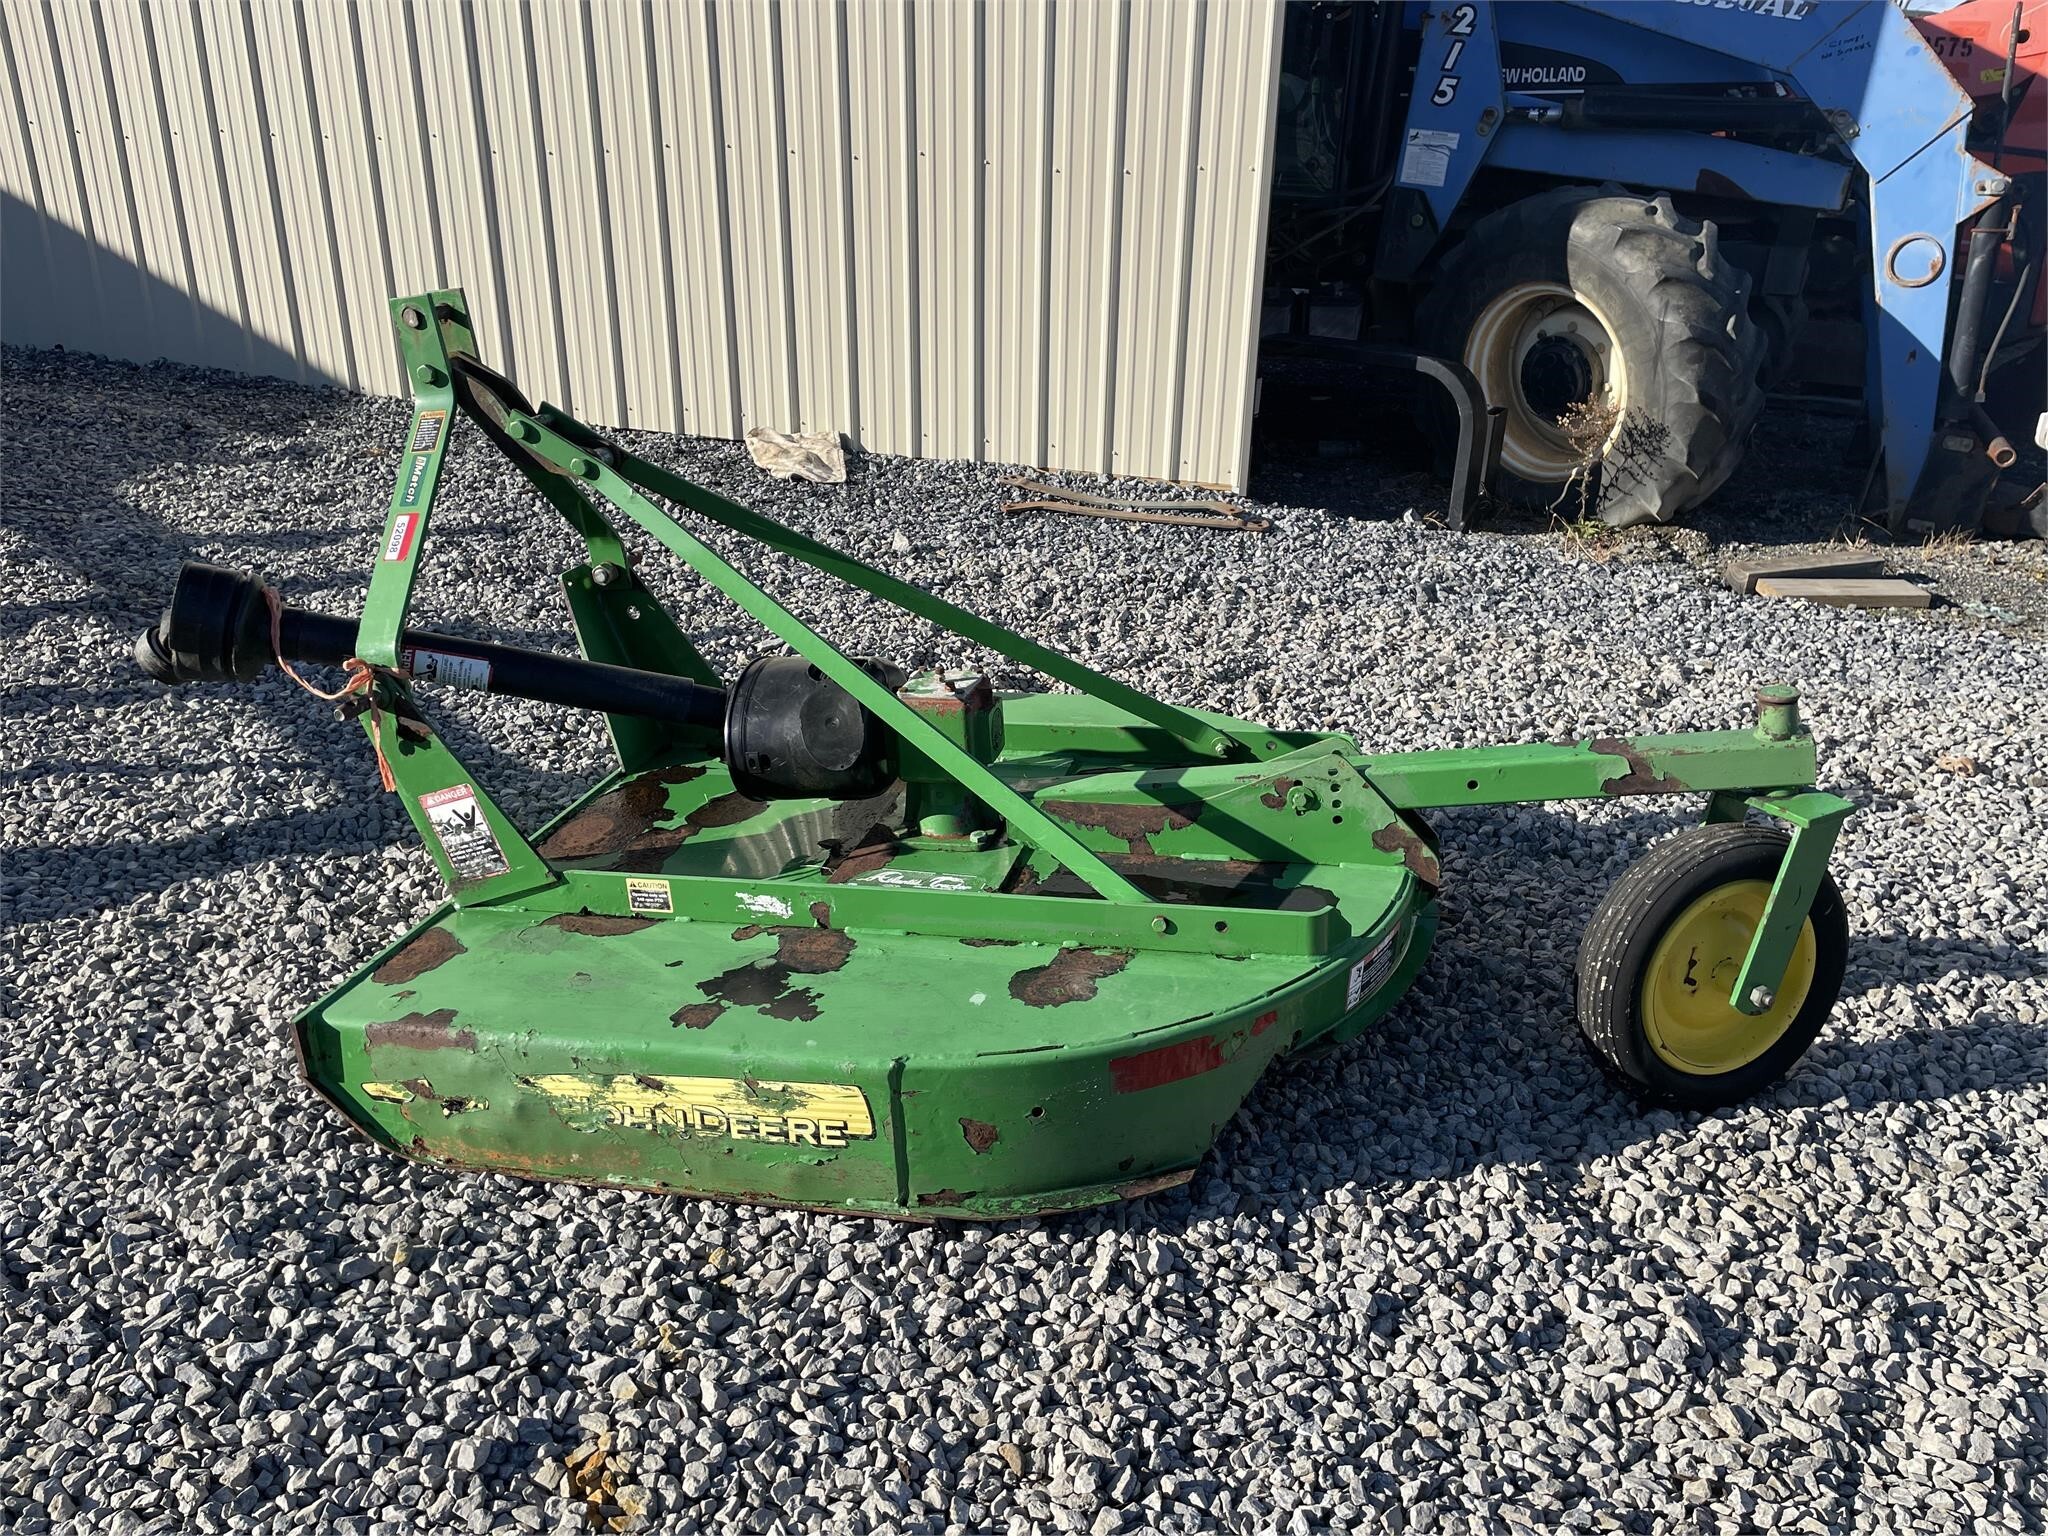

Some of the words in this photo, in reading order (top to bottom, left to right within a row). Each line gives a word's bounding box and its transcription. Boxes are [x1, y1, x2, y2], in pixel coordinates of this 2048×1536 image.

[1432, 4, 1476, 106] 215
[1925, 35, 1974, 57] 575
[1521, 67, 1586, 83] HOLLAND
[389, 522, 406, 554] 52098
[434, 787, 468, 802] DANGER
[637, 881, 668, 889] CAUTION
[596, 1103, 688, 1133] OHN
[692, 1104, 849, 1149] DEERE
